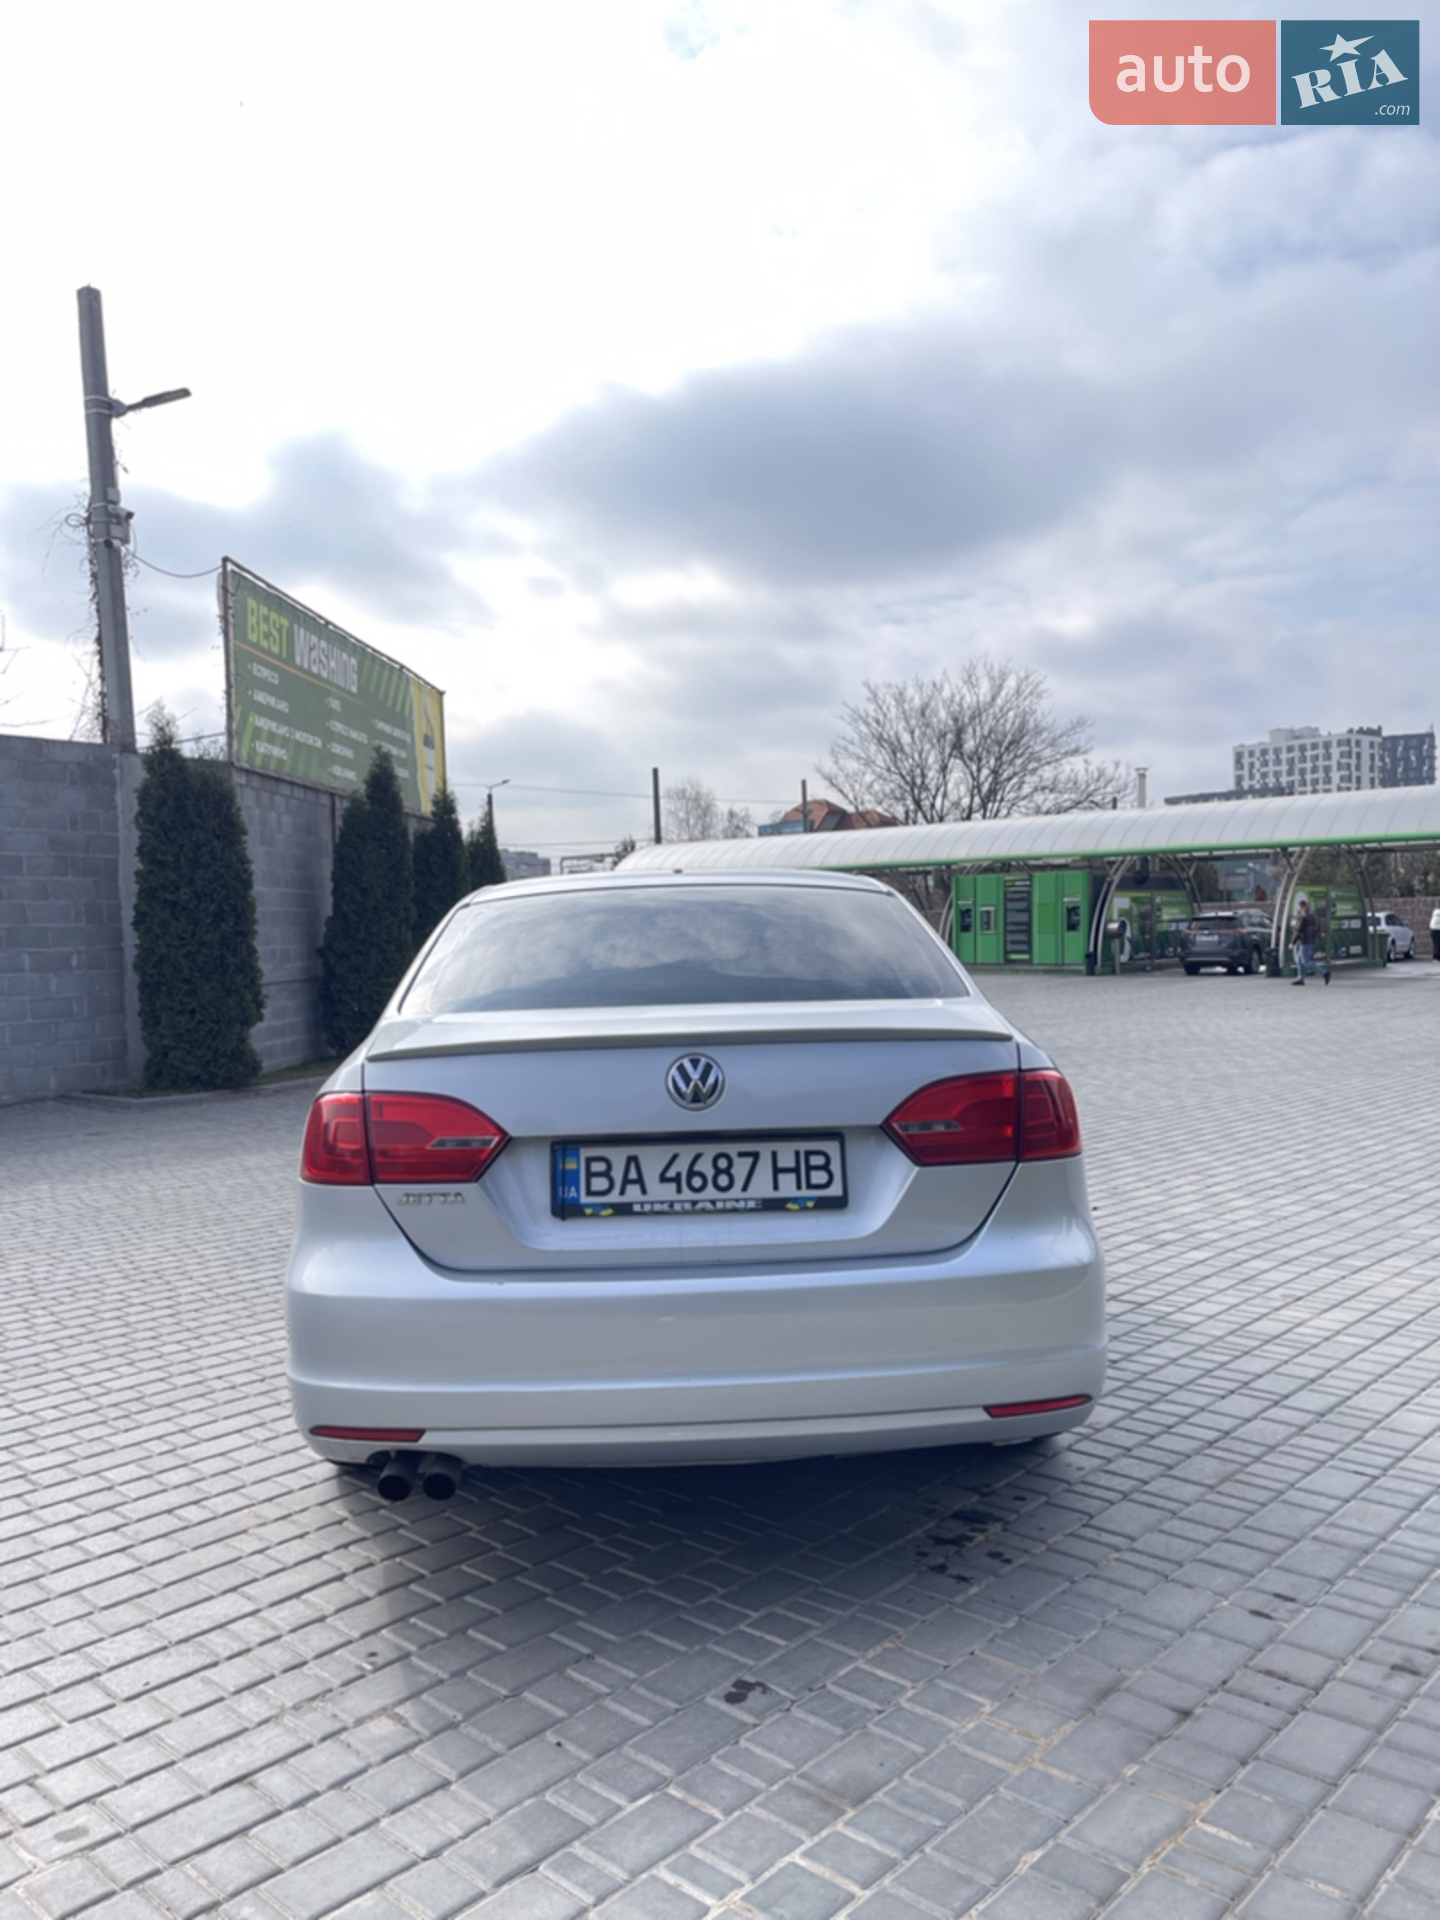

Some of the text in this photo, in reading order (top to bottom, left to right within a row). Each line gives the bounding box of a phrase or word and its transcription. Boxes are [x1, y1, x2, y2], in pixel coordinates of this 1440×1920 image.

[246, 596, 289, 660] BEST
[584, 1148, 835, 1198] BA 4687 HB
